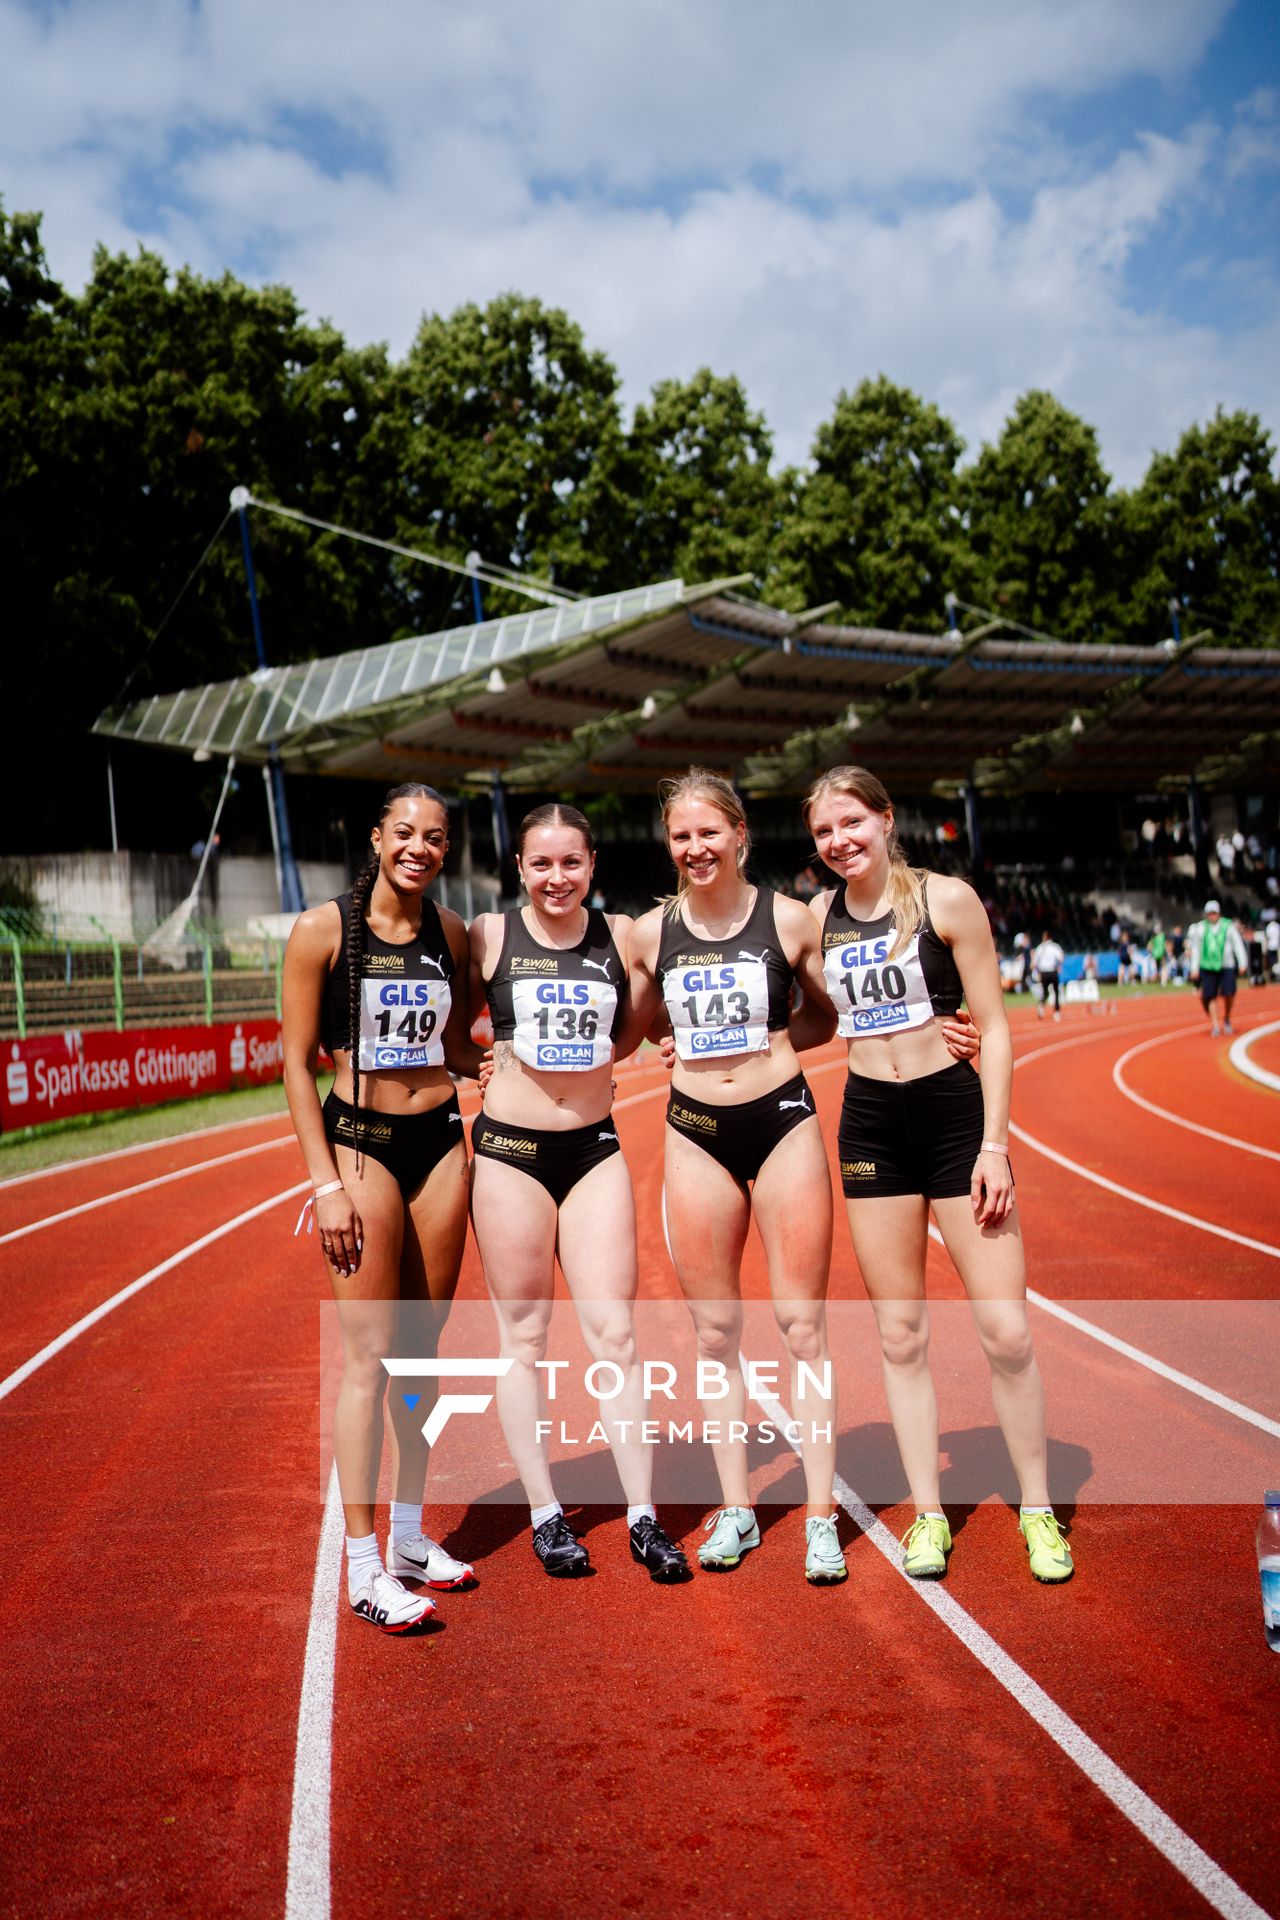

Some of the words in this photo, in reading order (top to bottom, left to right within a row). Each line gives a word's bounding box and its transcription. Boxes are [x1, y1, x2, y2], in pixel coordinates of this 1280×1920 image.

[840, 965, 907, 1006] 140
[533, 1007, 599, 1040] 136
[682, 991, 751, 1028] 143
[872, 1005, 905, 1020] PLAN
[375, 1009, 437, 1044] 149
[711, 1029, 744, 1043] PLAN
[400, 1050, 426, 1062] PLAN
[562, 1047, 592, 1058] PLAN
[34, 1053, 129, 1109] Sparkasse
[134, 1044, 217, 1088] Göttingen
